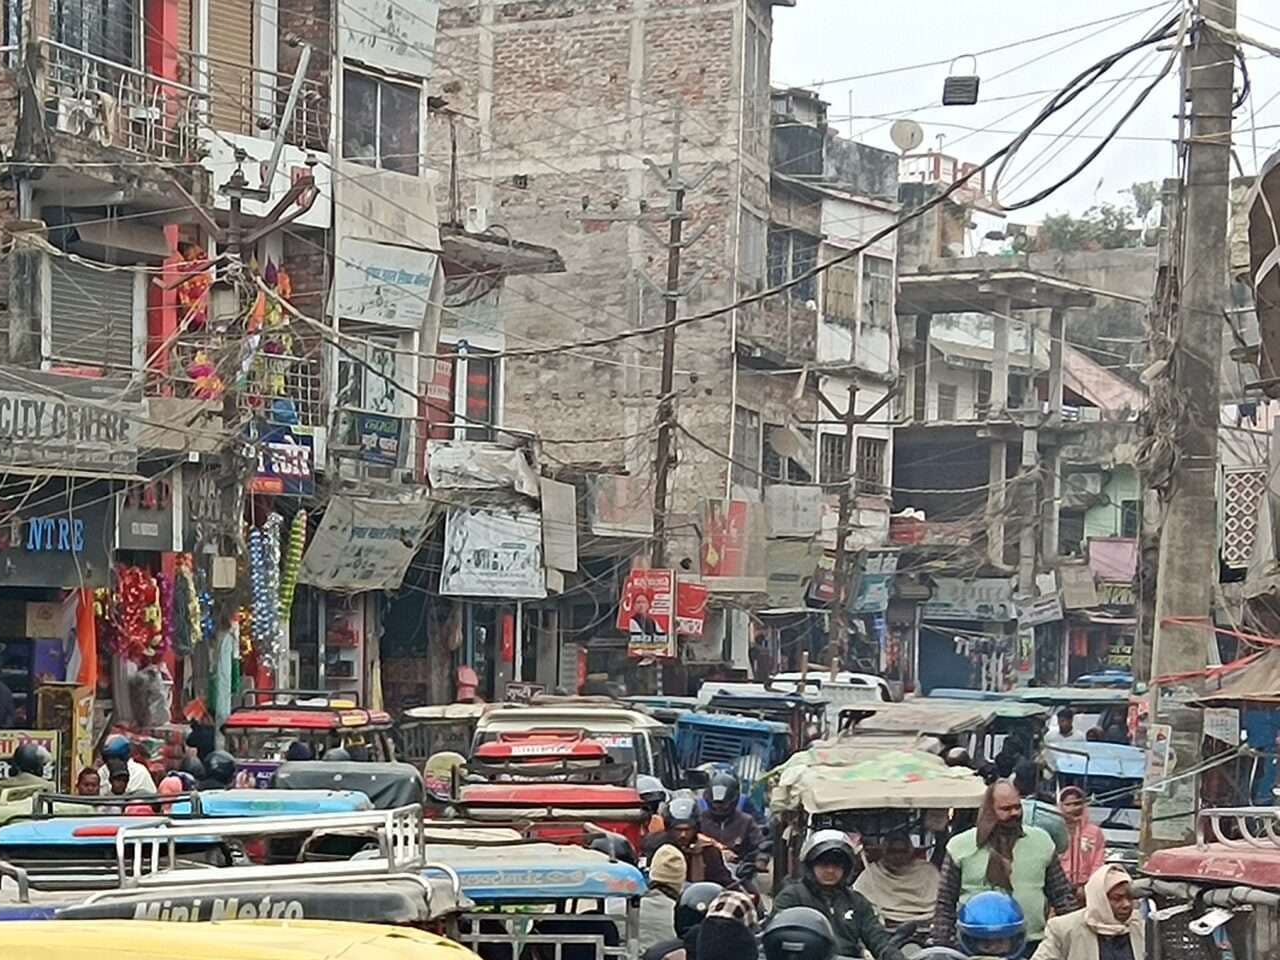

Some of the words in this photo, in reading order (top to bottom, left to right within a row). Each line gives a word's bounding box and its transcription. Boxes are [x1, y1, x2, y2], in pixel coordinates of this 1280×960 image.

[52, 401, 130, 442] CENTRE
[133, 899, 202, 922] Mini
[210, 895, 304, 923] Metro
